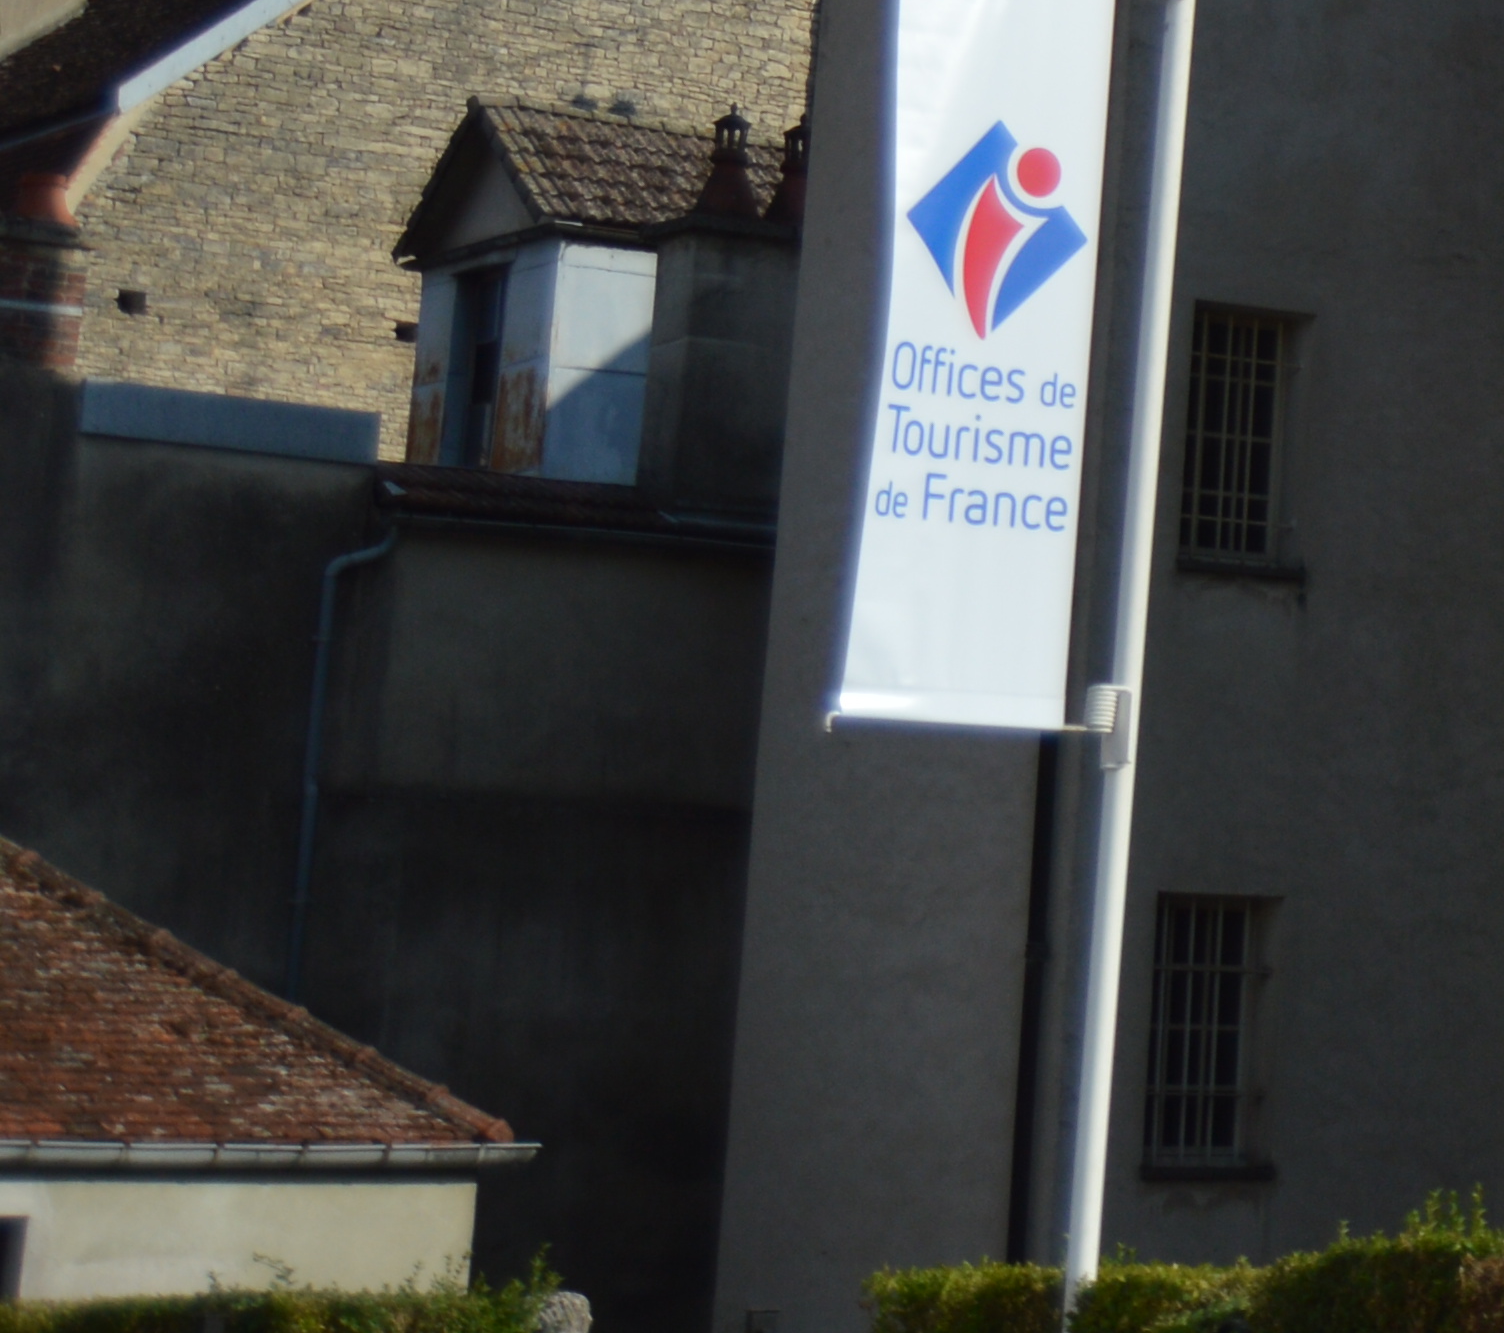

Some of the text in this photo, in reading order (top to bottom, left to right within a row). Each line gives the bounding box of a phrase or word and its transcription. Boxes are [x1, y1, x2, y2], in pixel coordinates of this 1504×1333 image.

[892, 341, 1077, 409] Offices de
[888, 403, 1073, 470] Tourisme
[875, 472, 1068, 532] de France
